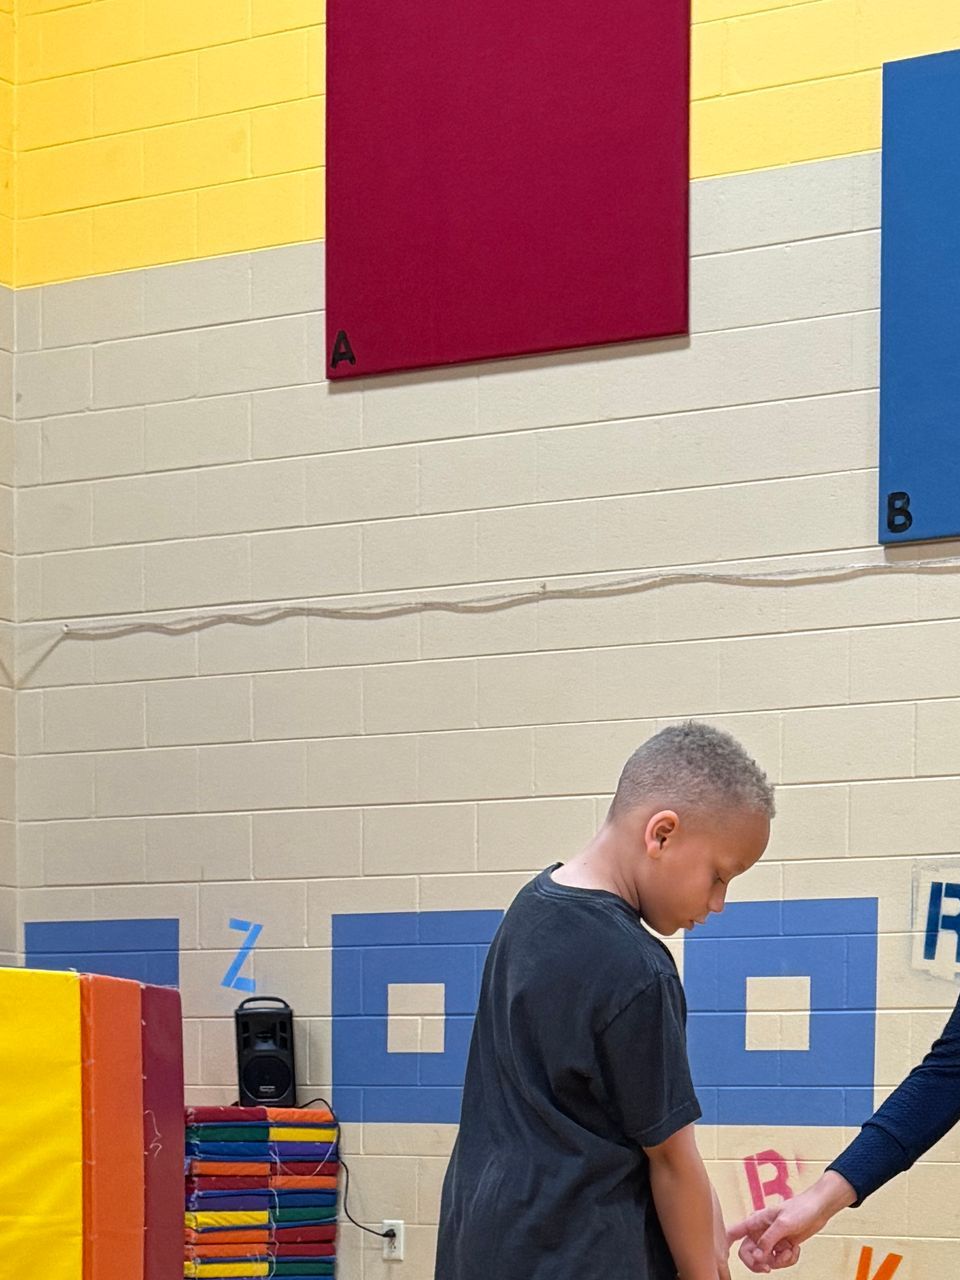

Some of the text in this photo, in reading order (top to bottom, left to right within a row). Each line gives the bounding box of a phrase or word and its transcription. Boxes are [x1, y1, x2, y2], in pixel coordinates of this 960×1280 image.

[330, 329, 357, 369] A
[886, 491, 913, 533] B
[221, 918, 263, 992] Z
[743, 1149, 794, 1212] R
